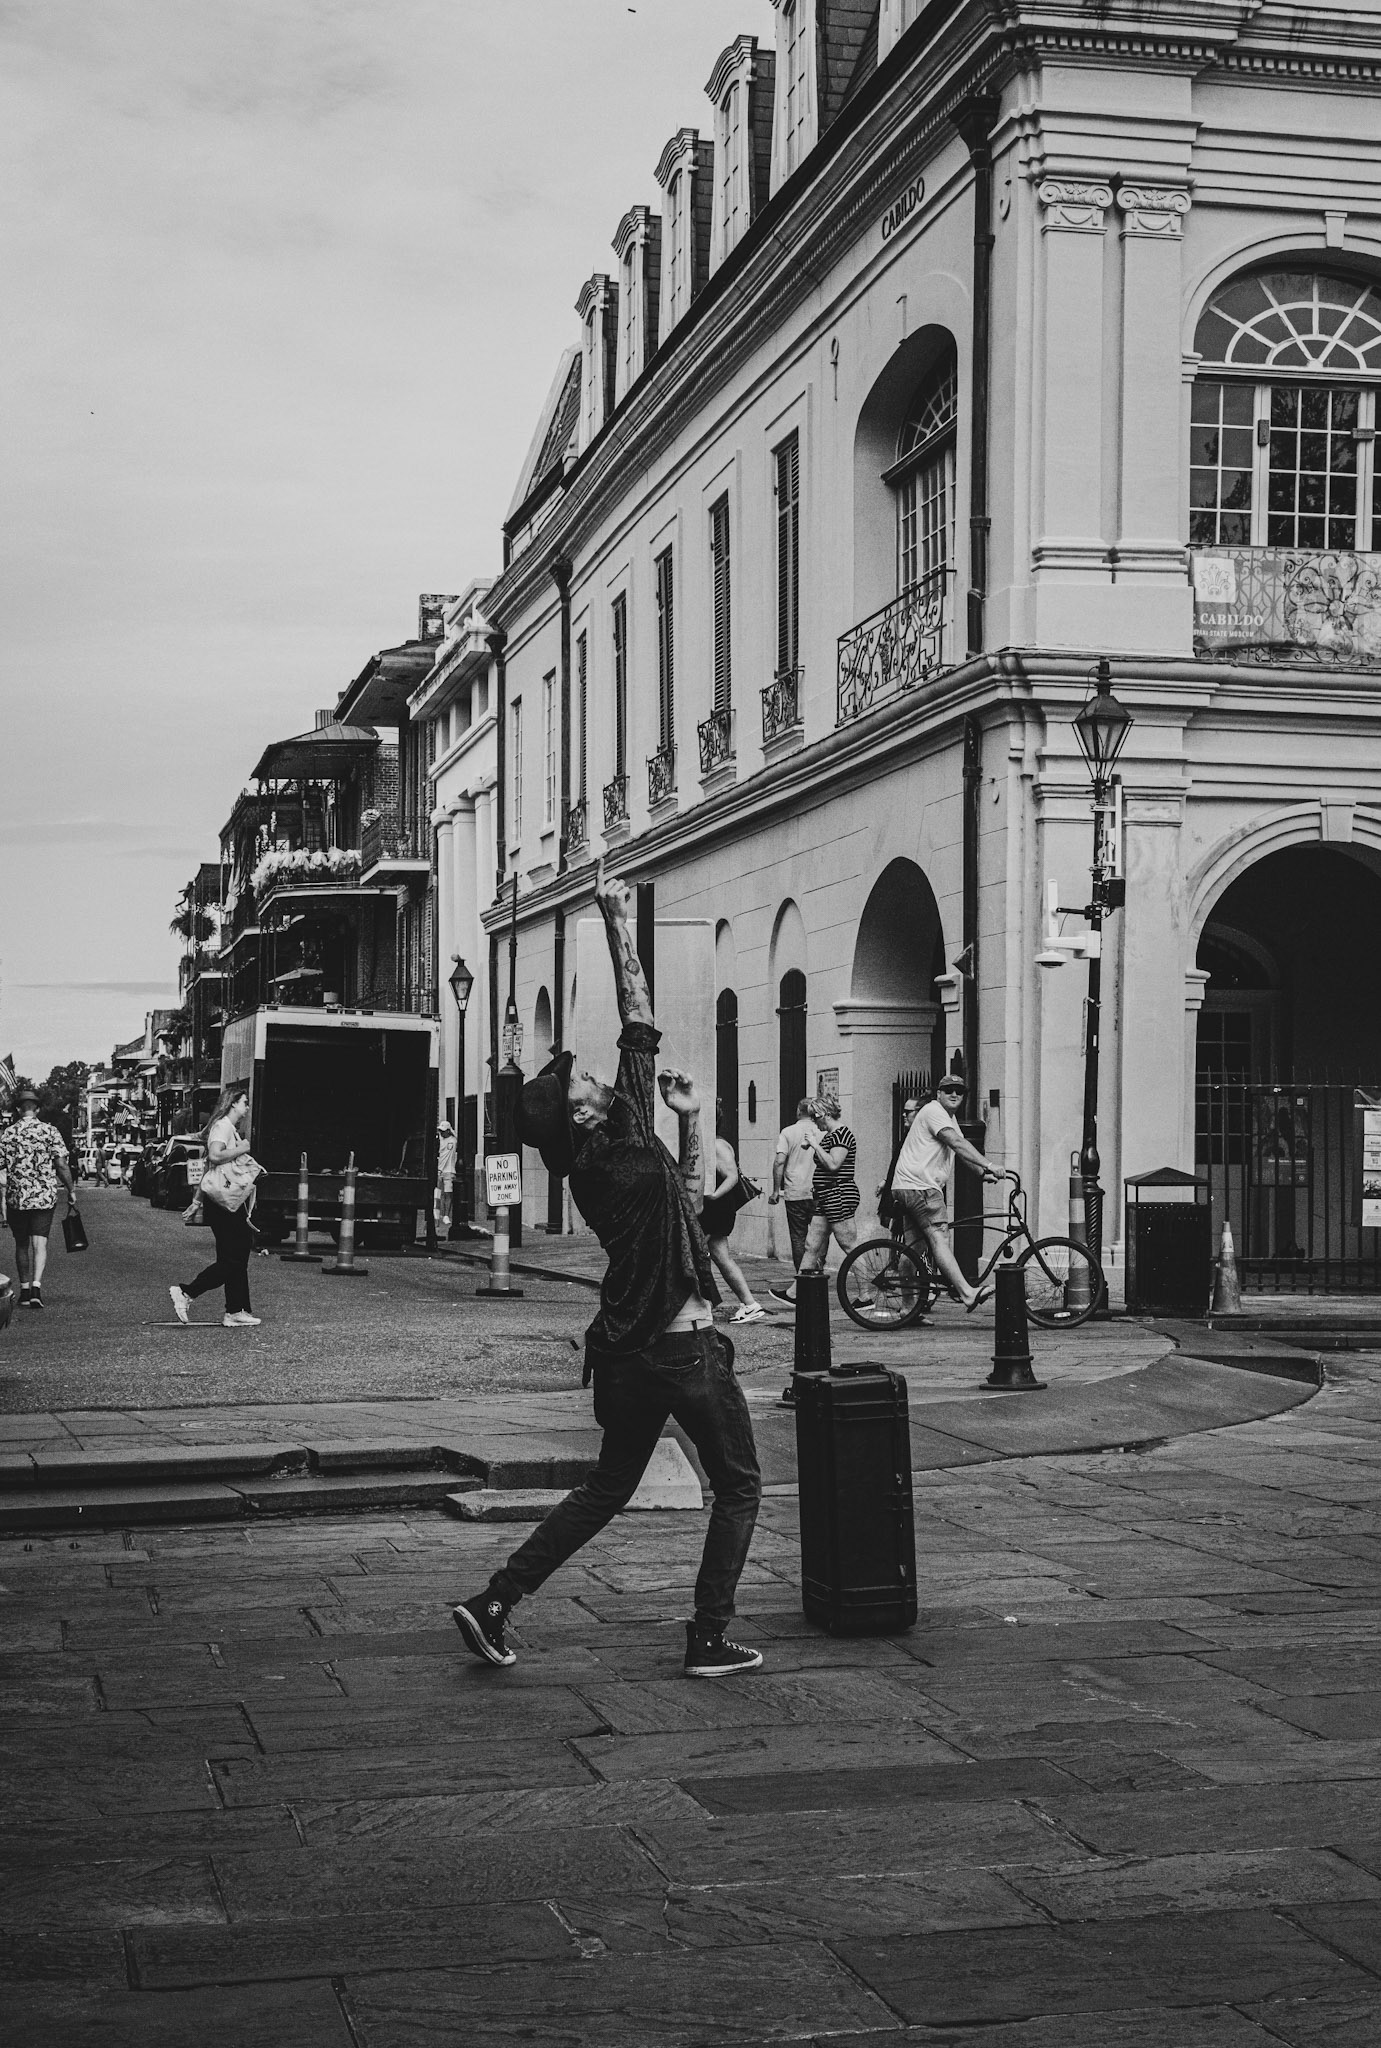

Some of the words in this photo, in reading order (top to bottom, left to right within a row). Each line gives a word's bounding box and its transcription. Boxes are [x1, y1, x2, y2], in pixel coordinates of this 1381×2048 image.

[882, 177, 925, 241] CABILDO
[1200, 613, 1264, 626] CABILDO
[1229, 630, 1254, 638] MUSEUM
[496, 1159, 509, 1170] NO
[489, 1171, 518, 1182] PARKING
[490, 1184, 502, 1192] TOW
[503, 1183, 518, 1191] AWAY
[497, 1193, 512, 1201] ZONE
